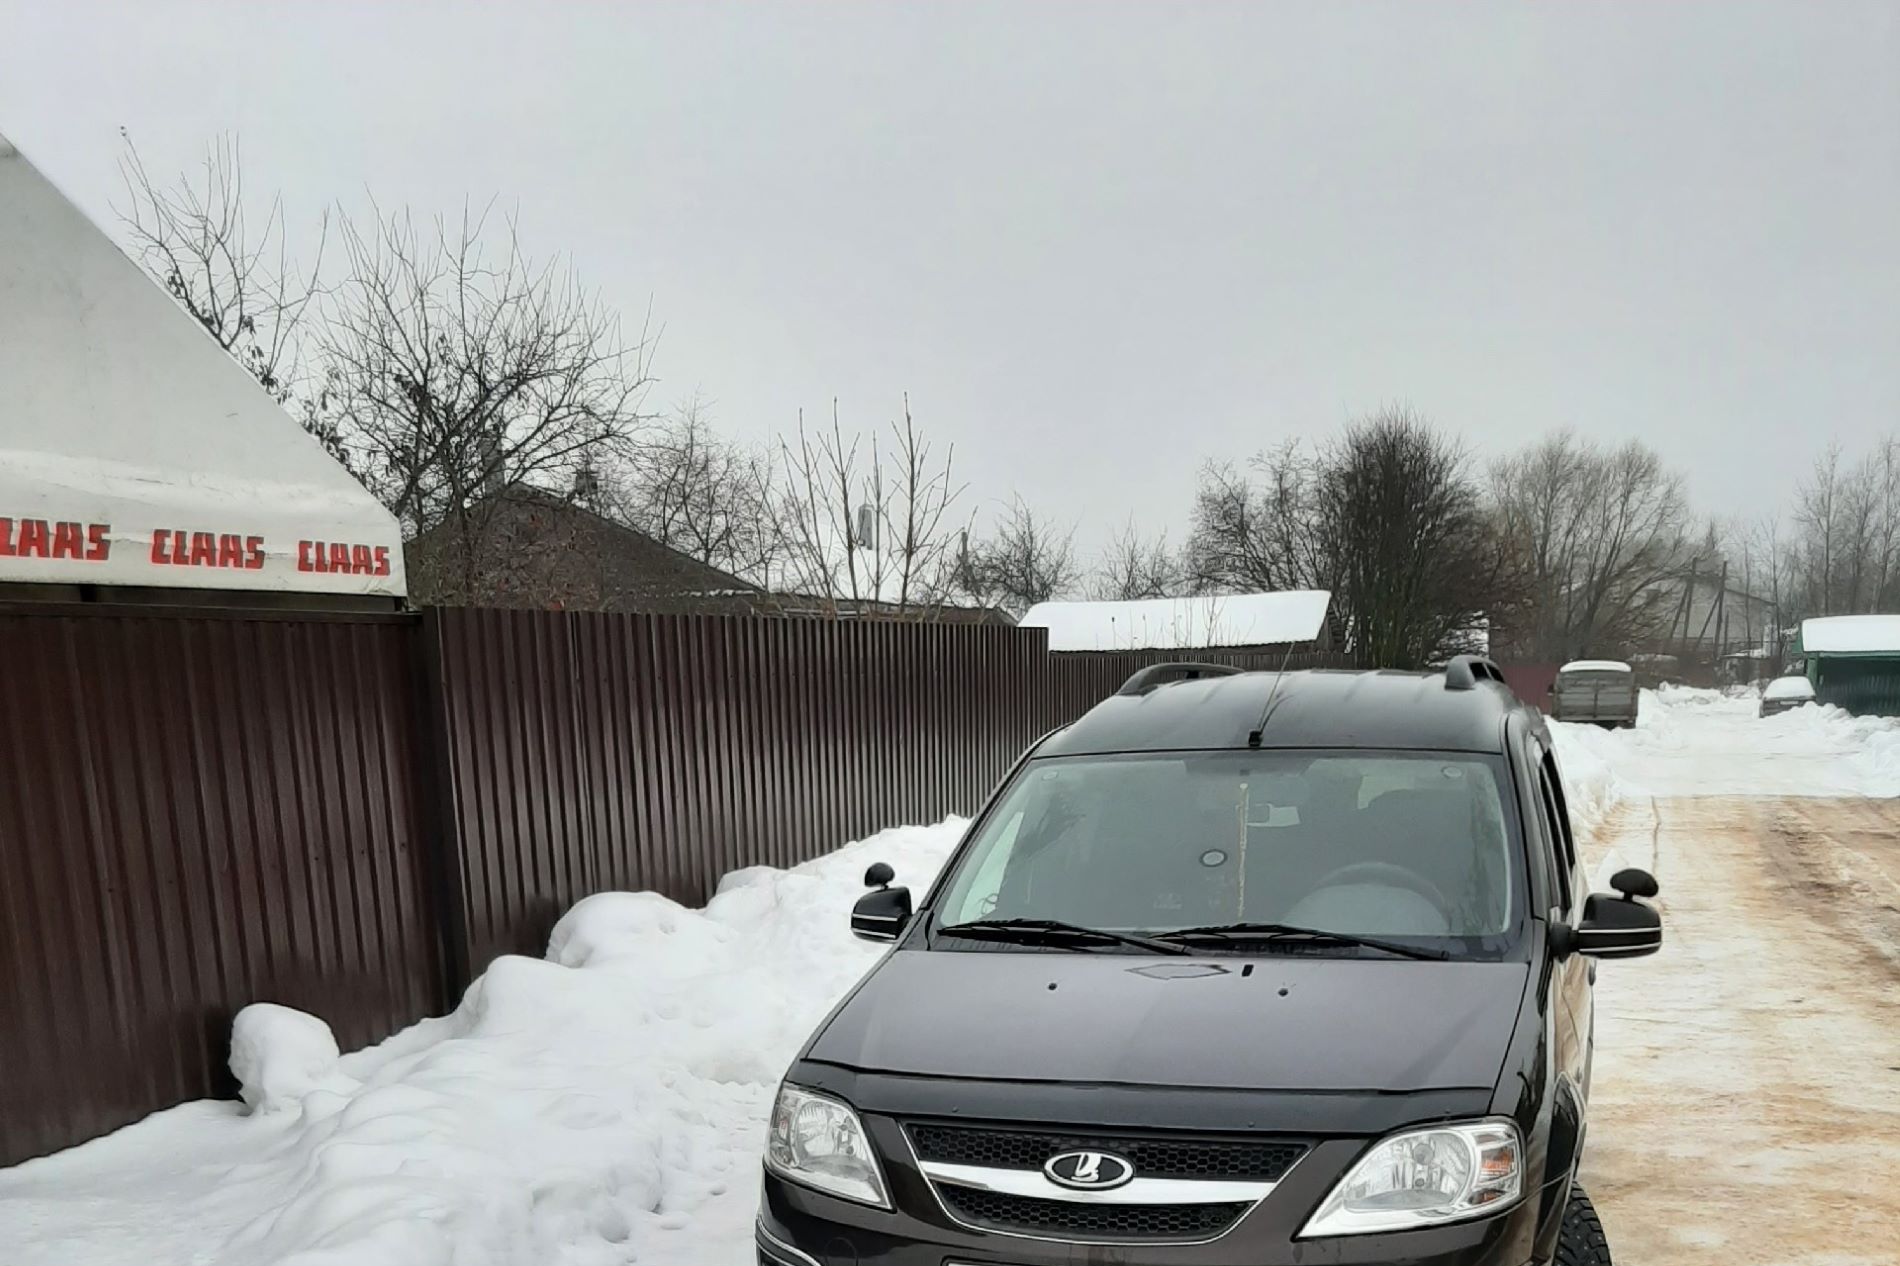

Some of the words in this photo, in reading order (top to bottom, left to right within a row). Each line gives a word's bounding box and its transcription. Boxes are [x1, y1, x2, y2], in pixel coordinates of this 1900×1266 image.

[0, 517, 111, 560] LAAS
[152, 529, 265, 569] CLAAS
[298, 540, 391, 576] CLAAS
